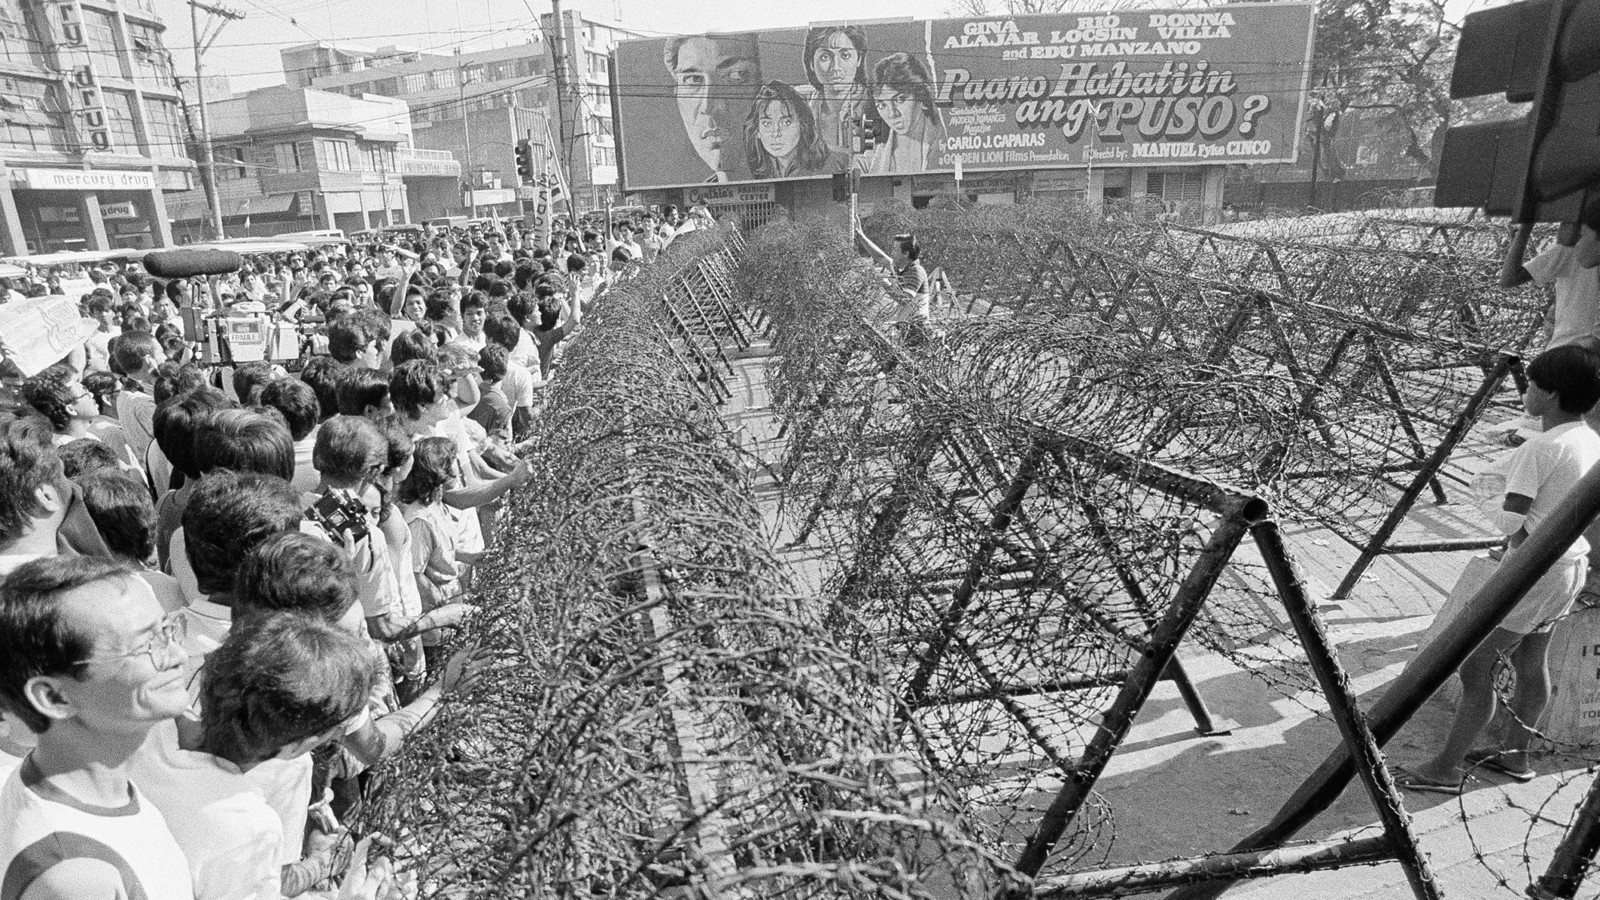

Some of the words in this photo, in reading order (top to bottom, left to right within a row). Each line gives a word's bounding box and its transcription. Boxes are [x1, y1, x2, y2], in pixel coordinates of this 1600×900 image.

[1077, 15, 1120, 30] RIO
[1148, 12, 1236, 27] DONNA
[963, 20, 1019, 36] GINA
[1049, 27, 1138, 44] LOCSIN
[1156, 25, 1231, 39] VILLA
[943, 32, 1041, 49] ALAJAR
[1002, 46, 1027, 60] and
[1030, 45, 1077, 59] EDU
[1080, 40, 1201, 57] MANZANO
[934, 68, 1049, 103] Paano
[1050, 59, 1237, 98] Hahatiin
[75, 65, 110, 151] drug
[1015, 98, 1091, 138] ang
[938, 139, 947, 154] by
[947, 135, 982, 150] CARLO
[982, 134, 993, 149] J.
[993, 132, 1046, 148] CAPARAS
[1131, 142, 1196, 158] MANUEL
[1197, 144, 1226, 158] Fyke
[1226, 139, 1272, 155] CINCO
[981, 149, 1005, 164] LION
[1005, 150, 1029, 163] Films
[53, 174, 115, 187] mercury
[120, 173, 150, 187] drug
[108, 206, 129, 216] drug
[231, 332, 257, 341] FRAGILE
